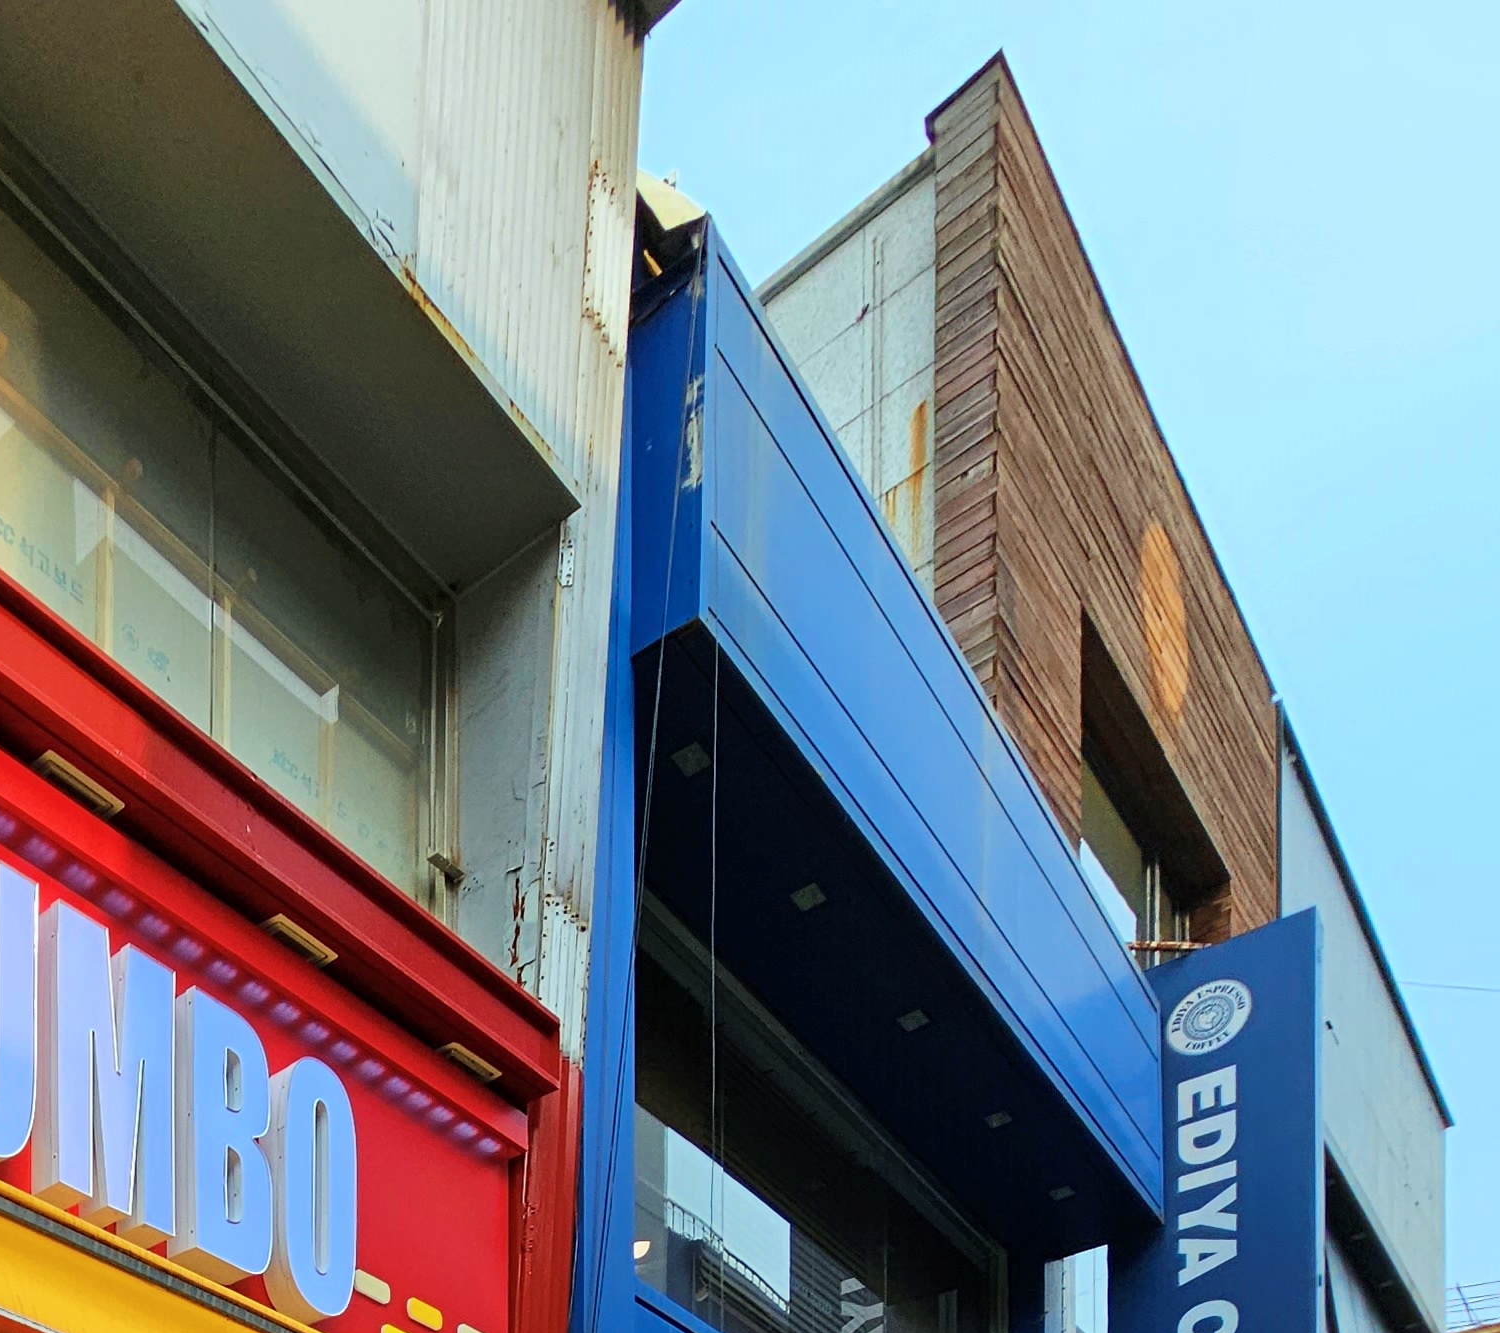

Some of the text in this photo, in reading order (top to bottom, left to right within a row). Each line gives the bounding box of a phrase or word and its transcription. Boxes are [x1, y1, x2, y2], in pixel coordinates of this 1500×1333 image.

[1172, 1000, 1194, 1033] EDIYA
[1186, 1031, 1231, 1050] COFFEE
[1176, 1064, 1238, 1287] EDIYA
